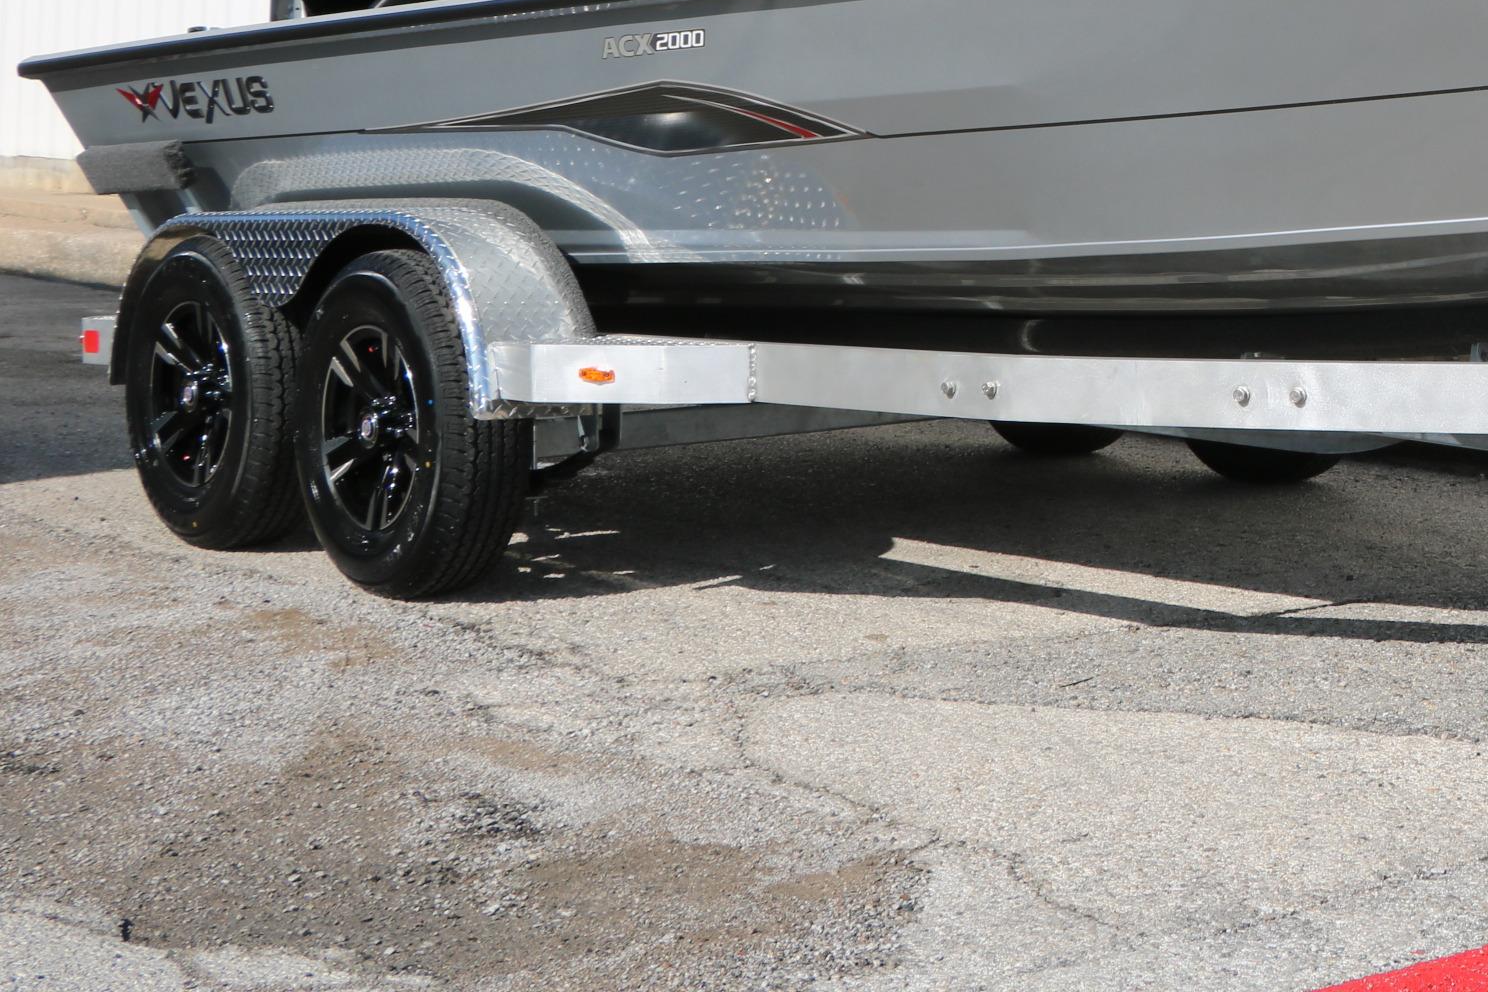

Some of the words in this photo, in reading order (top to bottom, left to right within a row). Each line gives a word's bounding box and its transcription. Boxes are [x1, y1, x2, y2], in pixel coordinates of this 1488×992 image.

[601, 33, 655, 59] ACX
[655, 29, 705, 51] 2000
[150, 75, 275, 124] VEXUS
